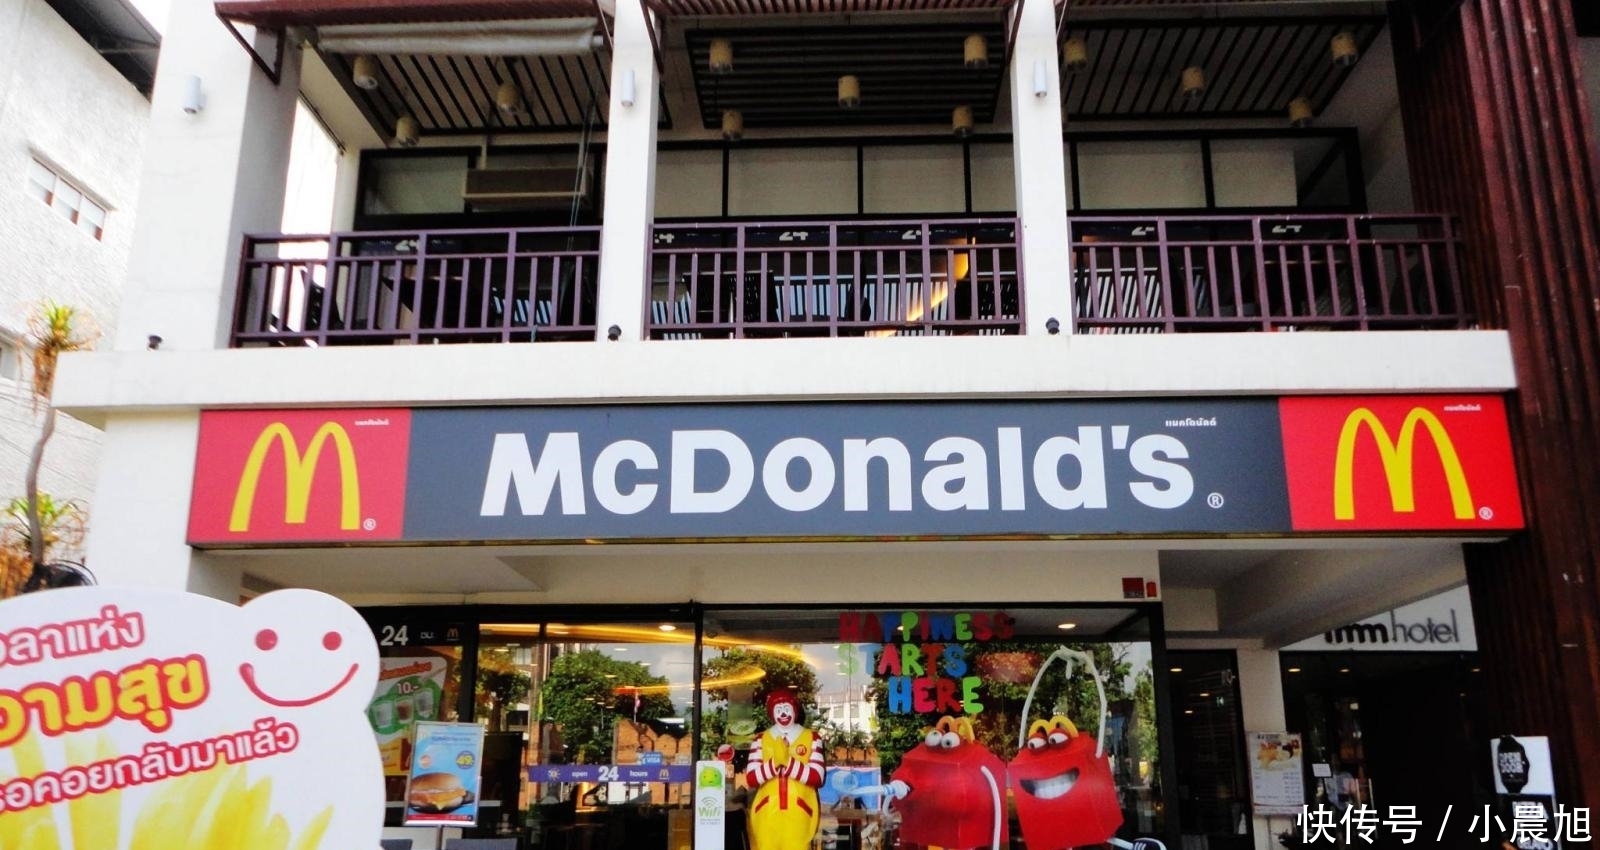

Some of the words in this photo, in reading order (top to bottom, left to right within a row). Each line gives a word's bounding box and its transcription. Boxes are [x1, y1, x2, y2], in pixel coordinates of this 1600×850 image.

[480, 425, 1195, 517] McDonald's
[380, 625, 408, 646] 24
[839, 611, 1016, 642] HAPPINESS
[837, 643, 967, 677] STARTS
[888, 676, 984, 714] HERE
[572, 770, 588, 779] open
[598, 766, 620, 781] 24
